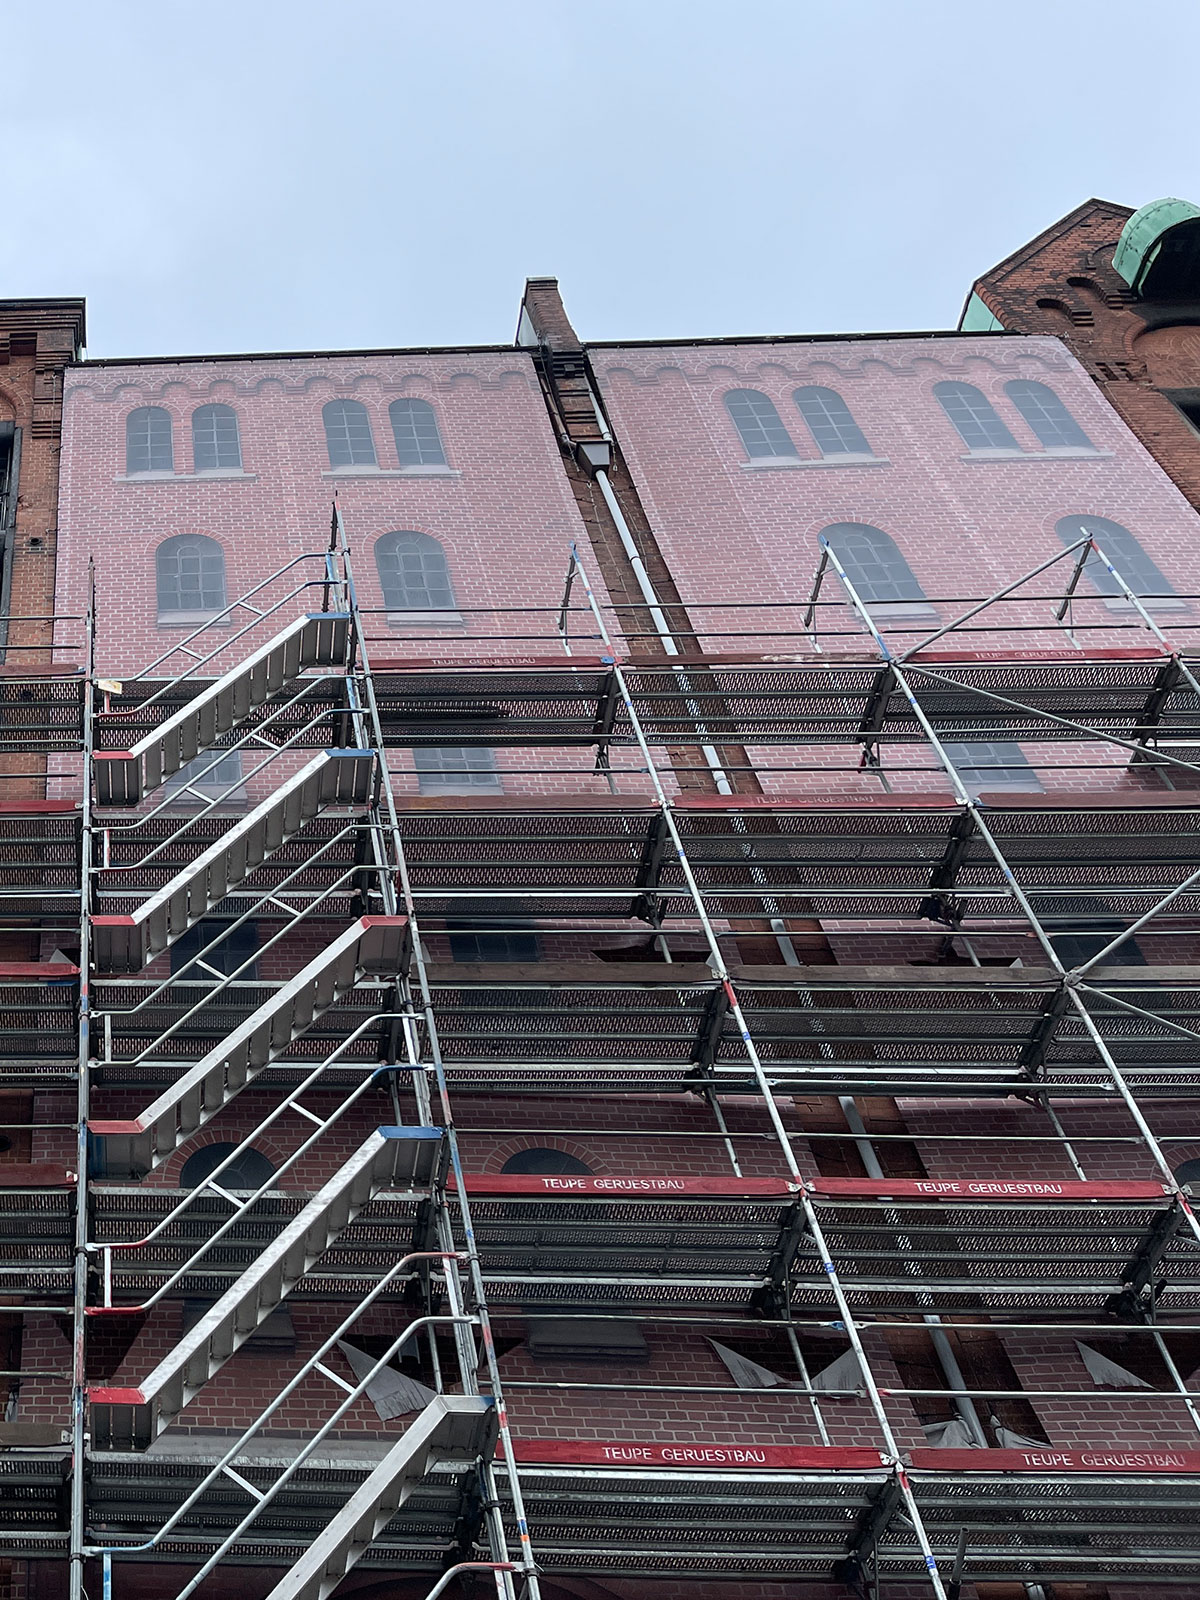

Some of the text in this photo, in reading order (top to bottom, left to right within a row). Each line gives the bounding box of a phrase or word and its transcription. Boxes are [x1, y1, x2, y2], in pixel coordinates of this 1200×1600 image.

[542, 1178, 685, 1190] TEUPE GERUESTBAU
[914, 1182, 1062, 1194] TEUPE GERUESTBAU
[602, 1447, 766, 1463] TEUPE GERUESTBAU
[1021, 1453, 1186, 1467] TEUPE GERUESTBAU
